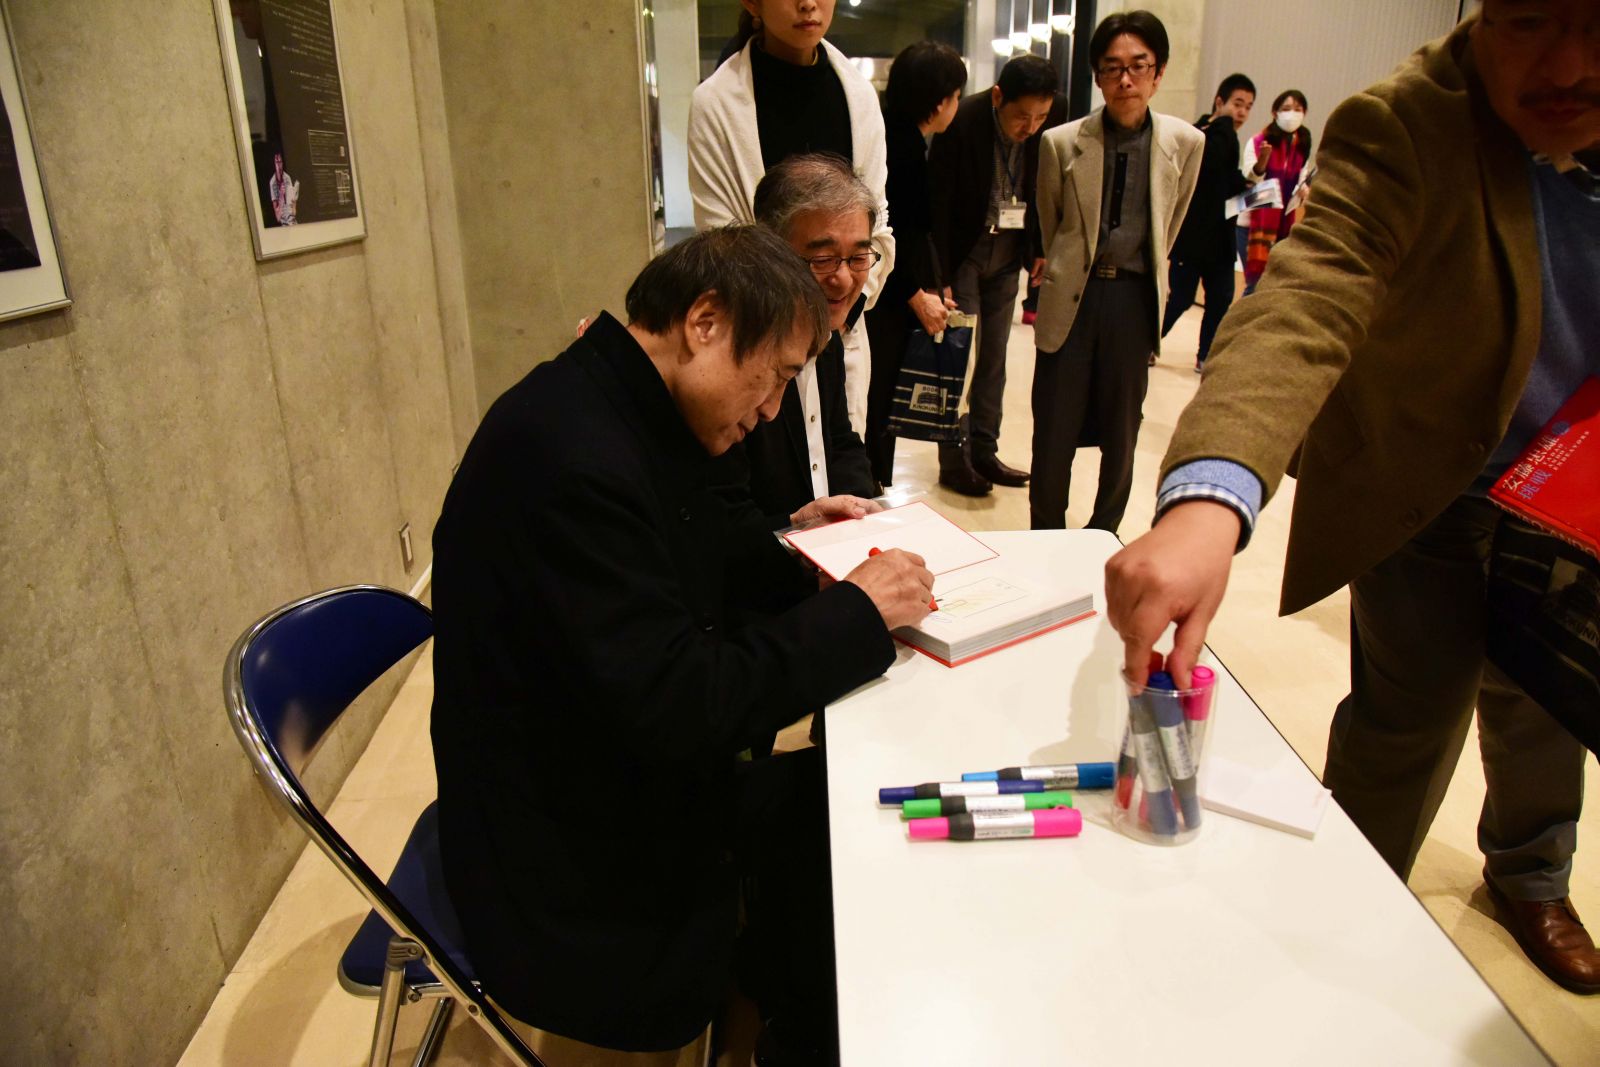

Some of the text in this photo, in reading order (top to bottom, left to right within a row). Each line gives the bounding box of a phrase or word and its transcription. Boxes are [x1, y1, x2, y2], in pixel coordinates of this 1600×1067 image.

[1502, 434, 1560, 493] 安藤忠雄
[1553, 431, 1590, 471] ENDEAVORS
[1517, 468, 1553, 500] 挑戦
